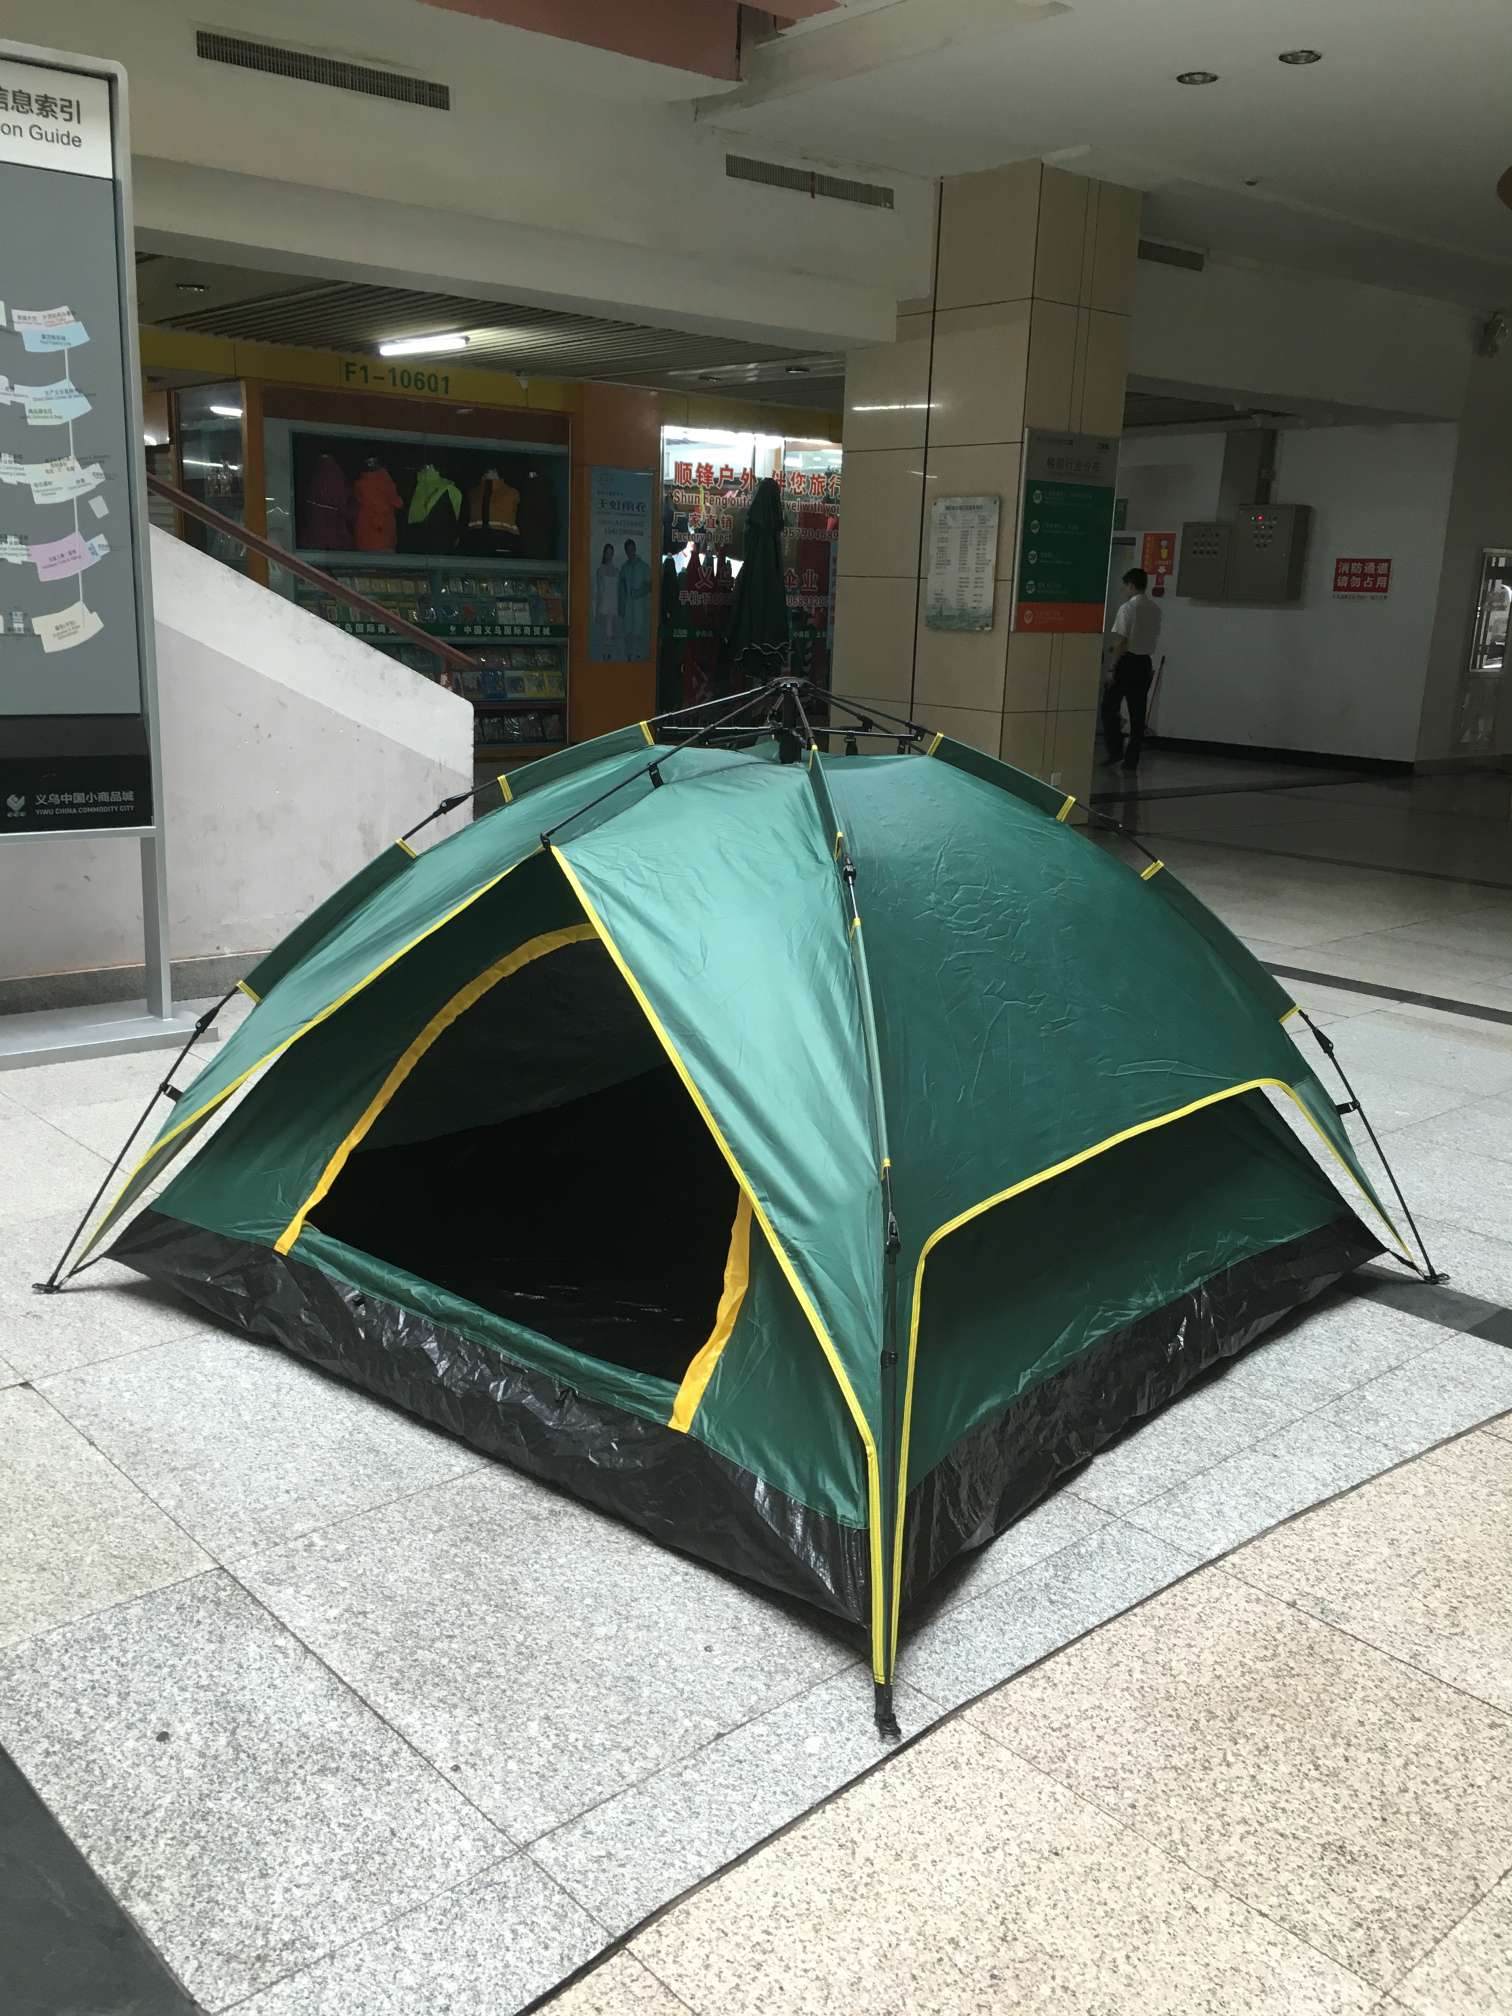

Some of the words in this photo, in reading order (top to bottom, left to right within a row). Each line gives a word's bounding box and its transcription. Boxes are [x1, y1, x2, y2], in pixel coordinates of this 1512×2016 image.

[29, 124, 82, 147] Guide
[344, 361, 449, 394] F1-10601
[672, 461, 758, 492] 顺锋户外
[672, 489, 701, 505] Shun
[1337, 561, 1389, 574] 消防通道
[1336, 576, 1388, 588] 请勿占用
[35, 791, 134, 805] 义乌中国小商品城
[35, 808, 54, 816] YIWU
[55, 807, 77, 815] CHINA
[78, 805, 118, 813] COMMODITY
